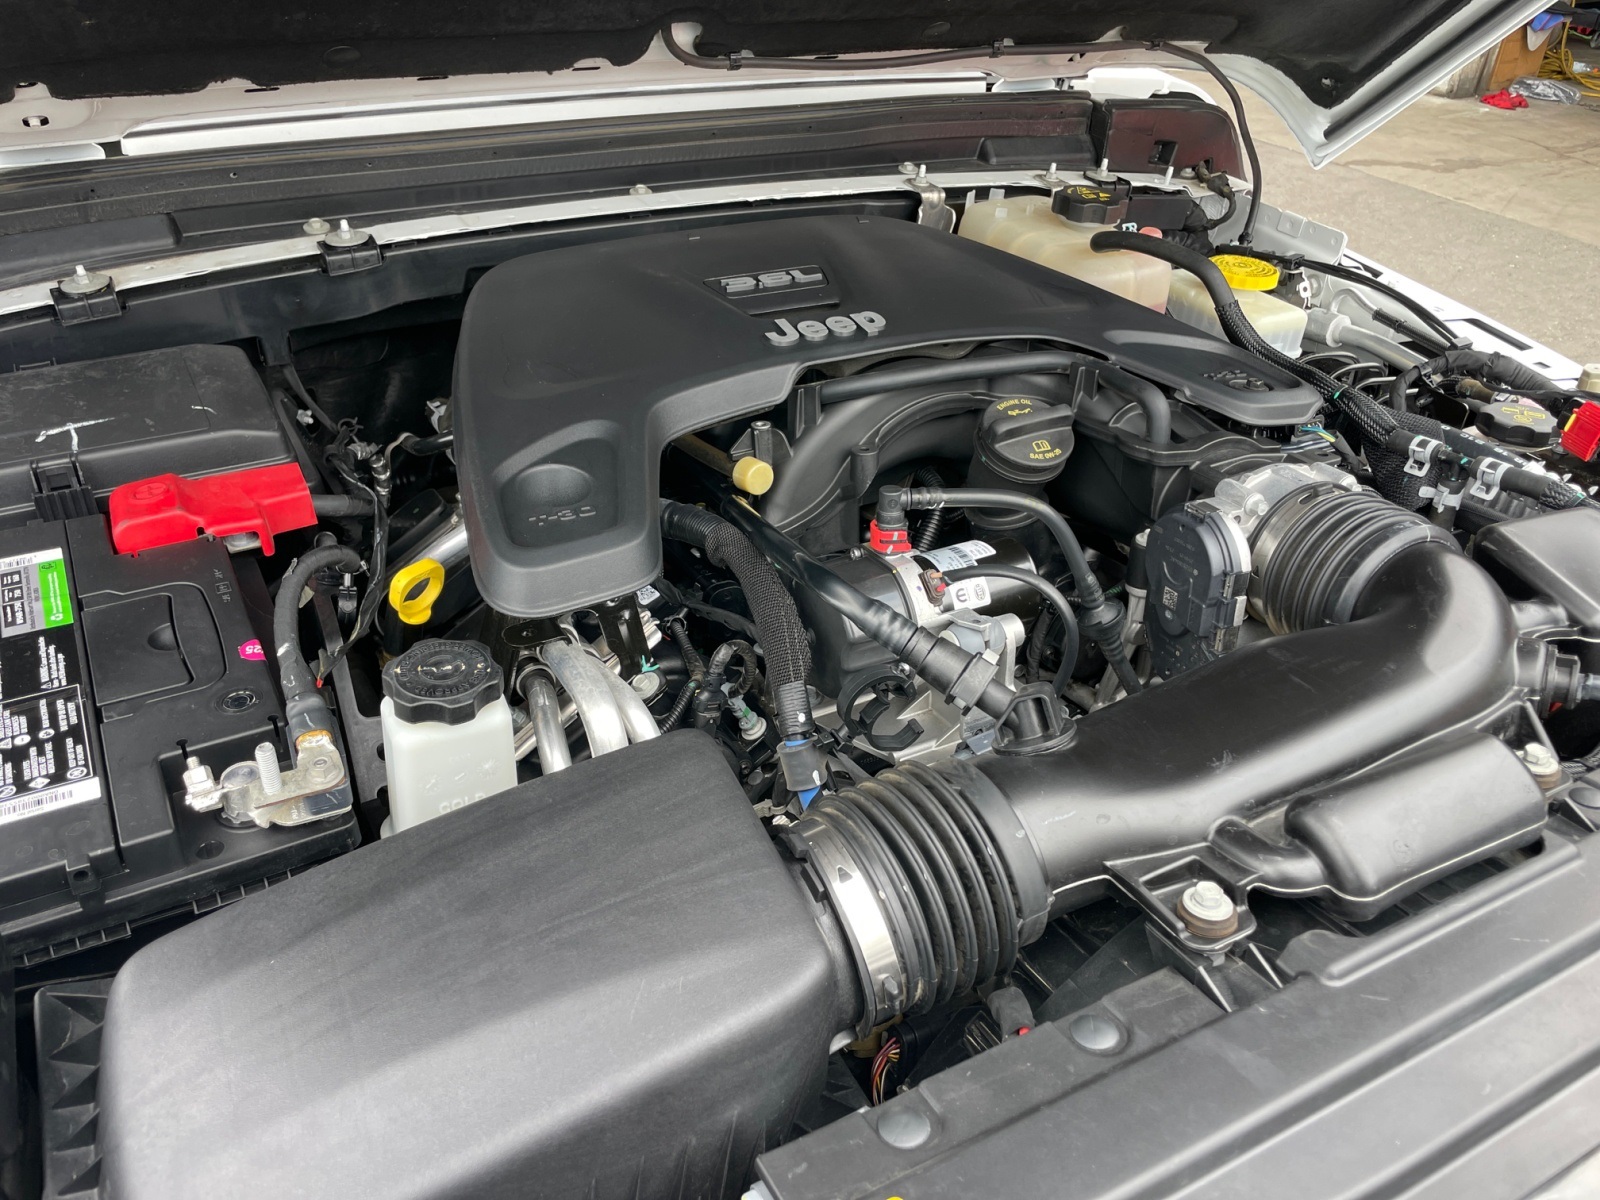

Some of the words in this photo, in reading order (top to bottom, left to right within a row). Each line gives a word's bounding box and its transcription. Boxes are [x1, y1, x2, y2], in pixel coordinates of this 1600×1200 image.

[764, 311, 887, 347] Jeep
[996, 399, 1020, 411] ENGINE
[1029, 452, 1045, 460] SAE
